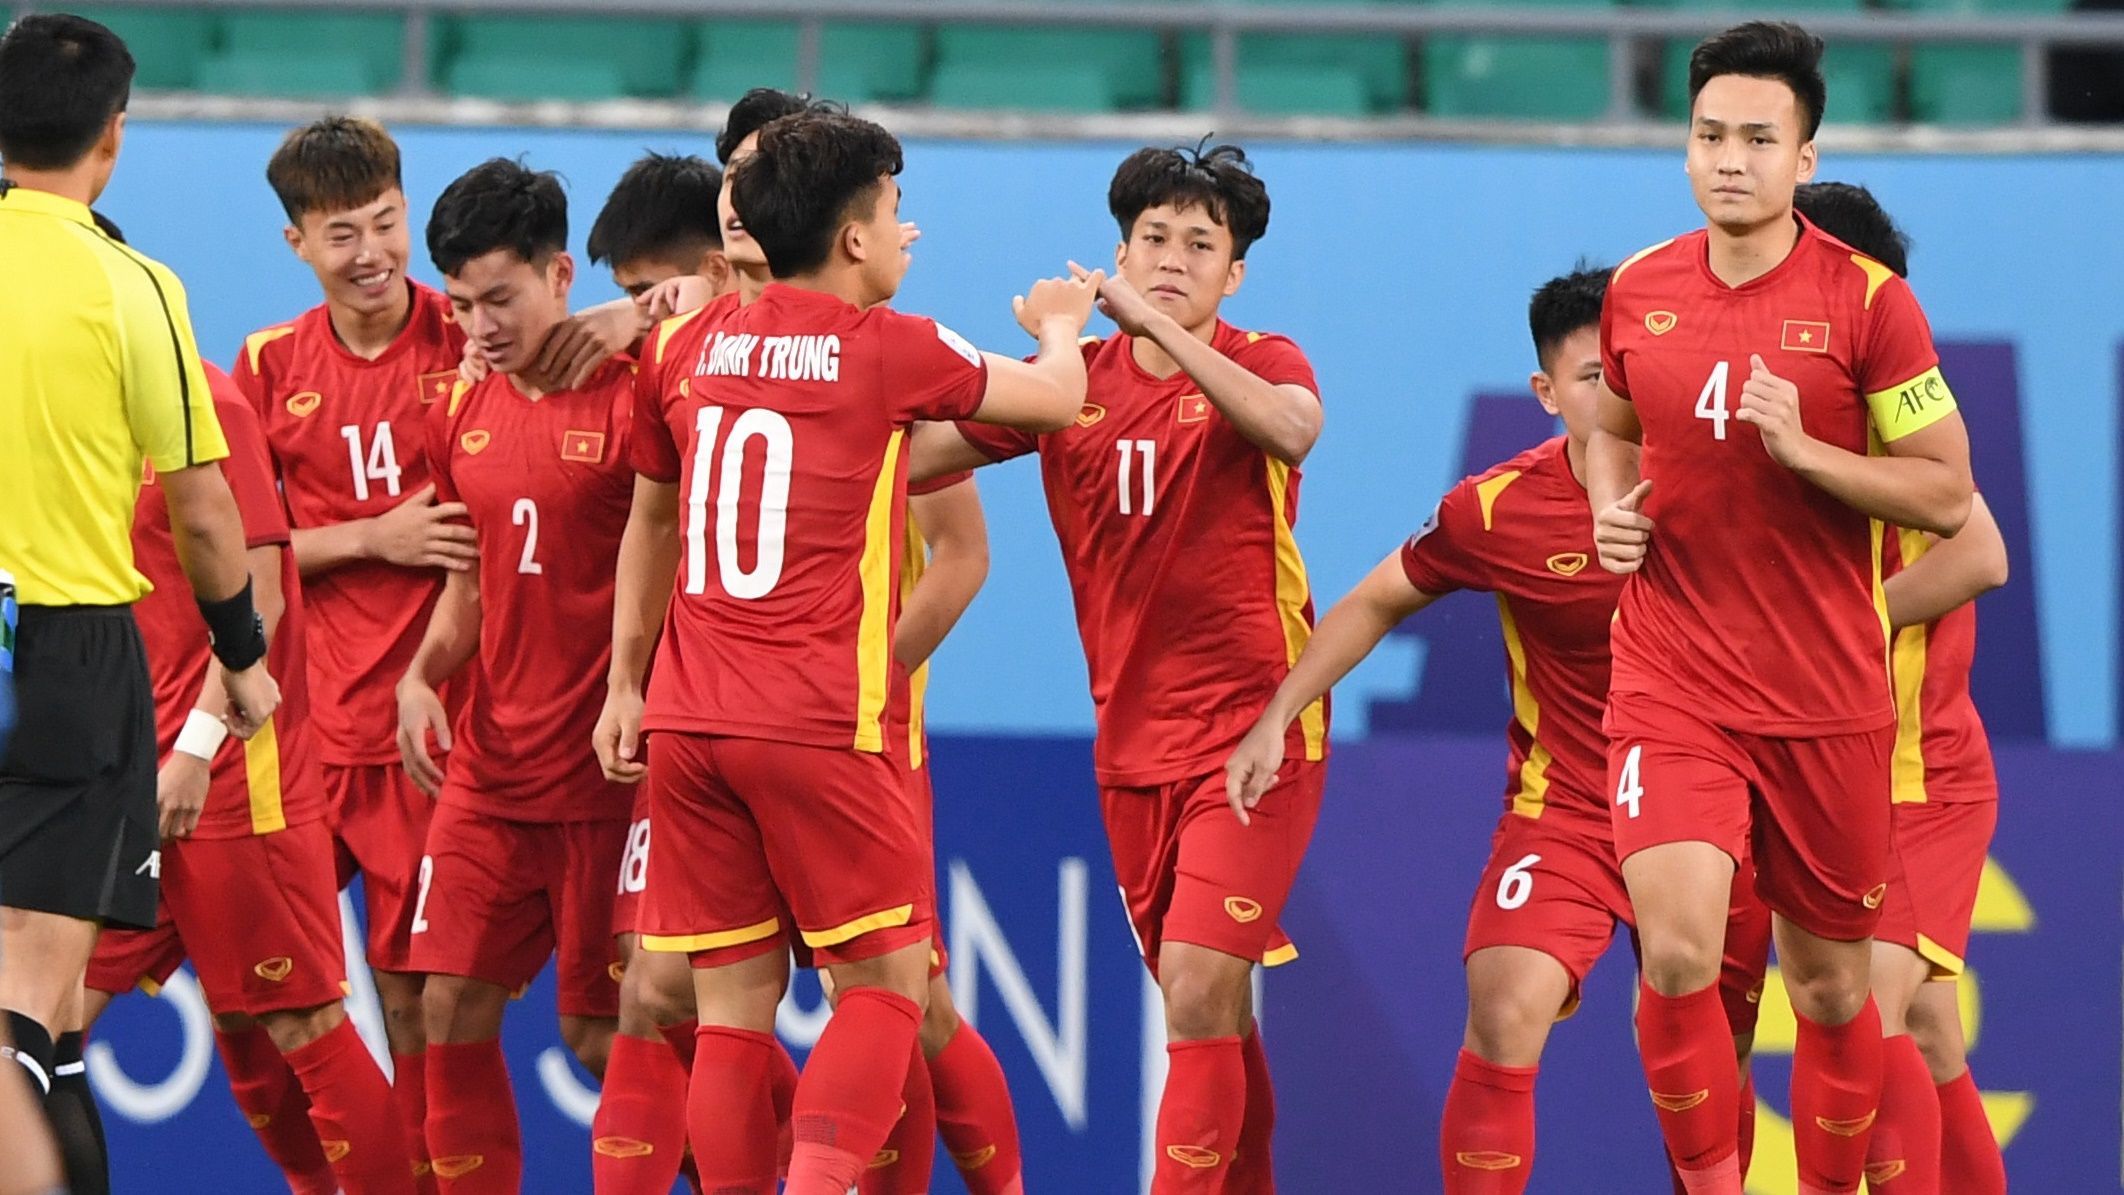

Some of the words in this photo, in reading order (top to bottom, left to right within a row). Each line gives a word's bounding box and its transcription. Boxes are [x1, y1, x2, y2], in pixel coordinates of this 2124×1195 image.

[757, 333, 841, 383] TRUNG
[1694, 360, 1730, 440] 4
[1894, 376, 1945, 424] AFC
[340, 420, 402, 501] 14
[1116, 439, 1156, 516] 11
[512, 497, 543, 575] 2
[684, 405, 794, 600] 10
[1616, 744, 1645, 819] 4
[410, 854, 434, 934] 2
[617, 818, 651, 896] 18
[1496, 853, 1543, 910] 6
